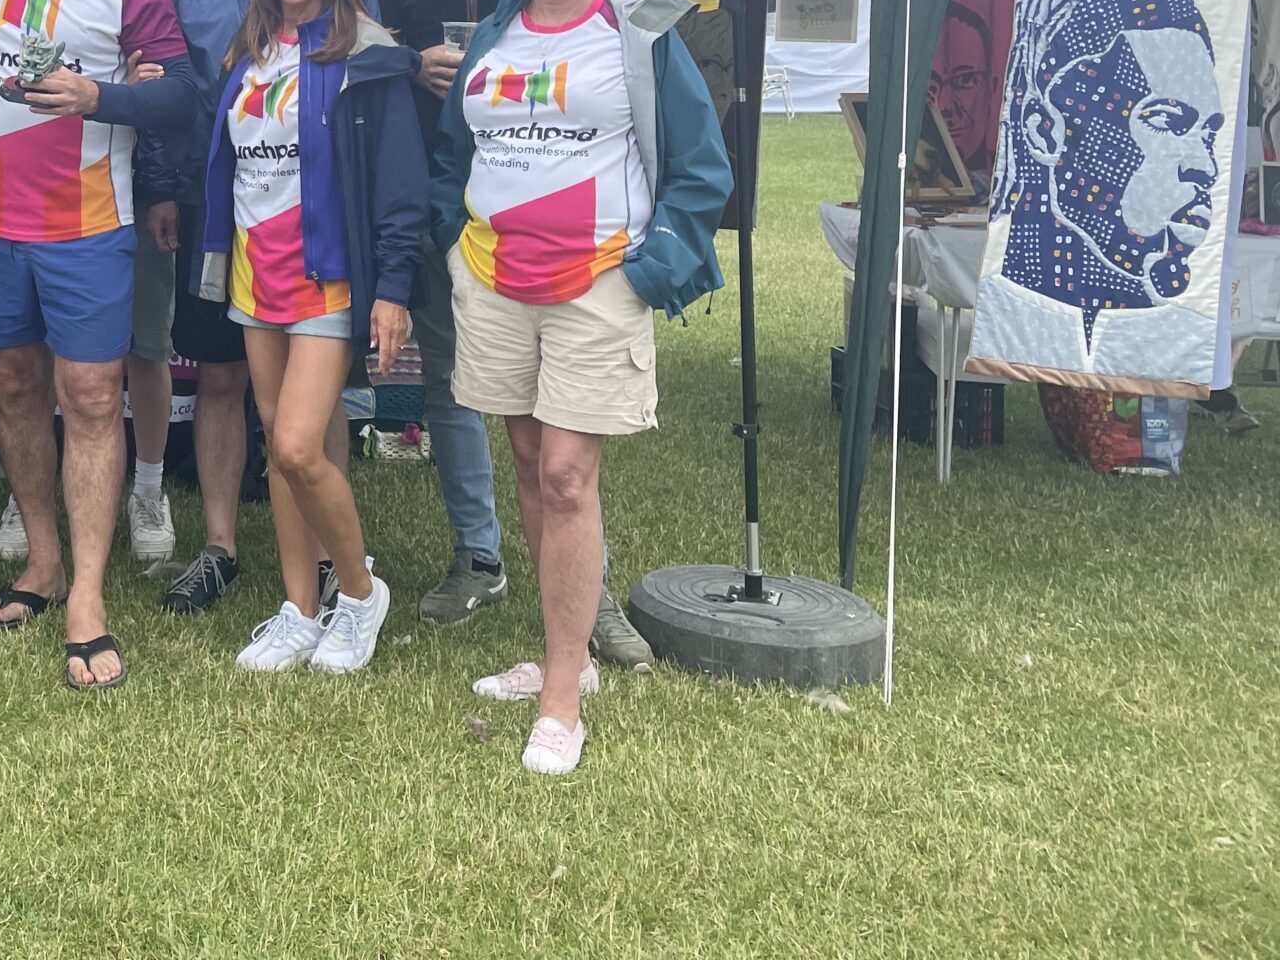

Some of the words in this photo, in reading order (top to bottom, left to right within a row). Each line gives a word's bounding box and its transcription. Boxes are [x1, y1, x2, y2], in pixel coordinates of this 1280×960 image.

[476, 122, 598, 142] aunchpad
[509, 144, 589, 157] homelessness
[488, 156, 530, 171] Reading
